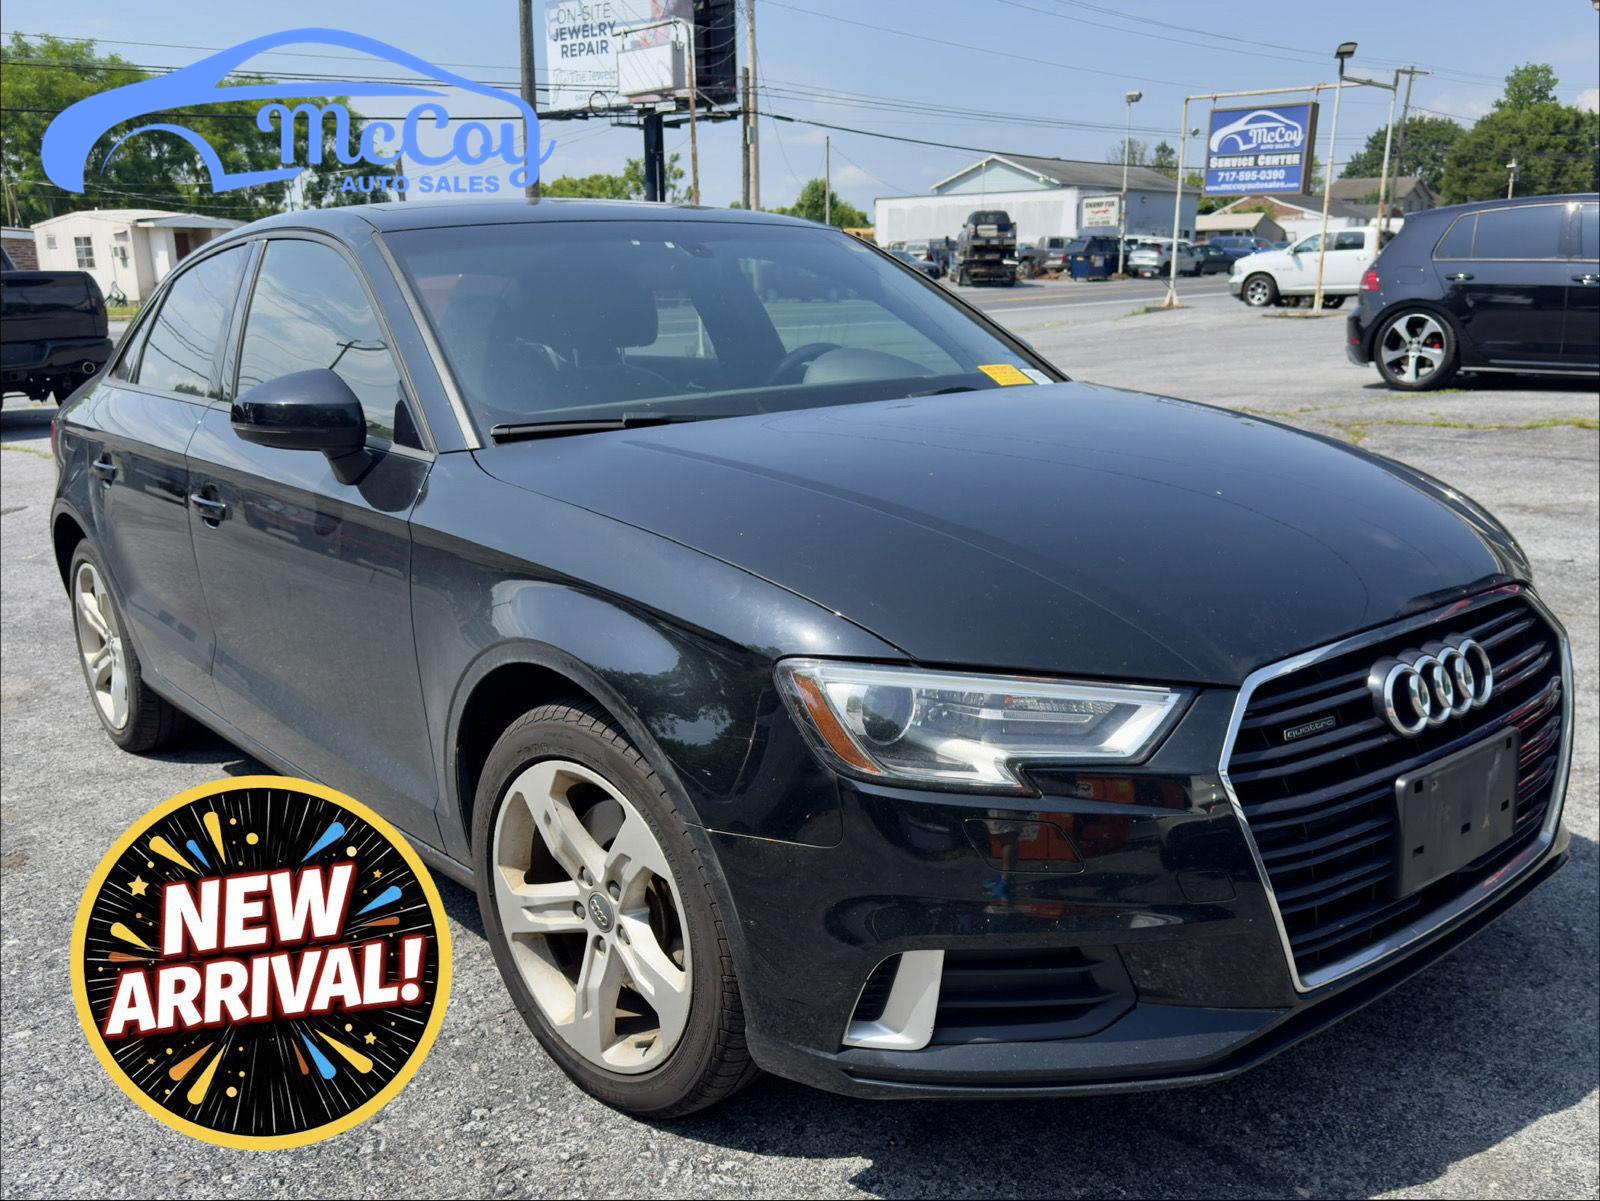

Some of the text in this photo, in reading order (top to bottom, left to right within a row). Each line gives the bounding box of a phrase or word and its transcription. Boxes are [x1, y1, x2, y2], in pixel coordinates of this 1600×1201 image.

[556, 2, 611, 24] ON-SITE
[553, 21, 616, 42] JEWELRY
[560, 40, 609, 59] REPAIR
[1249, 126, 1304, 147] McCoy
[1209, 153, 1300, 168] SERVICE CENTER
[1286, 719, 1334, 739] quattro
